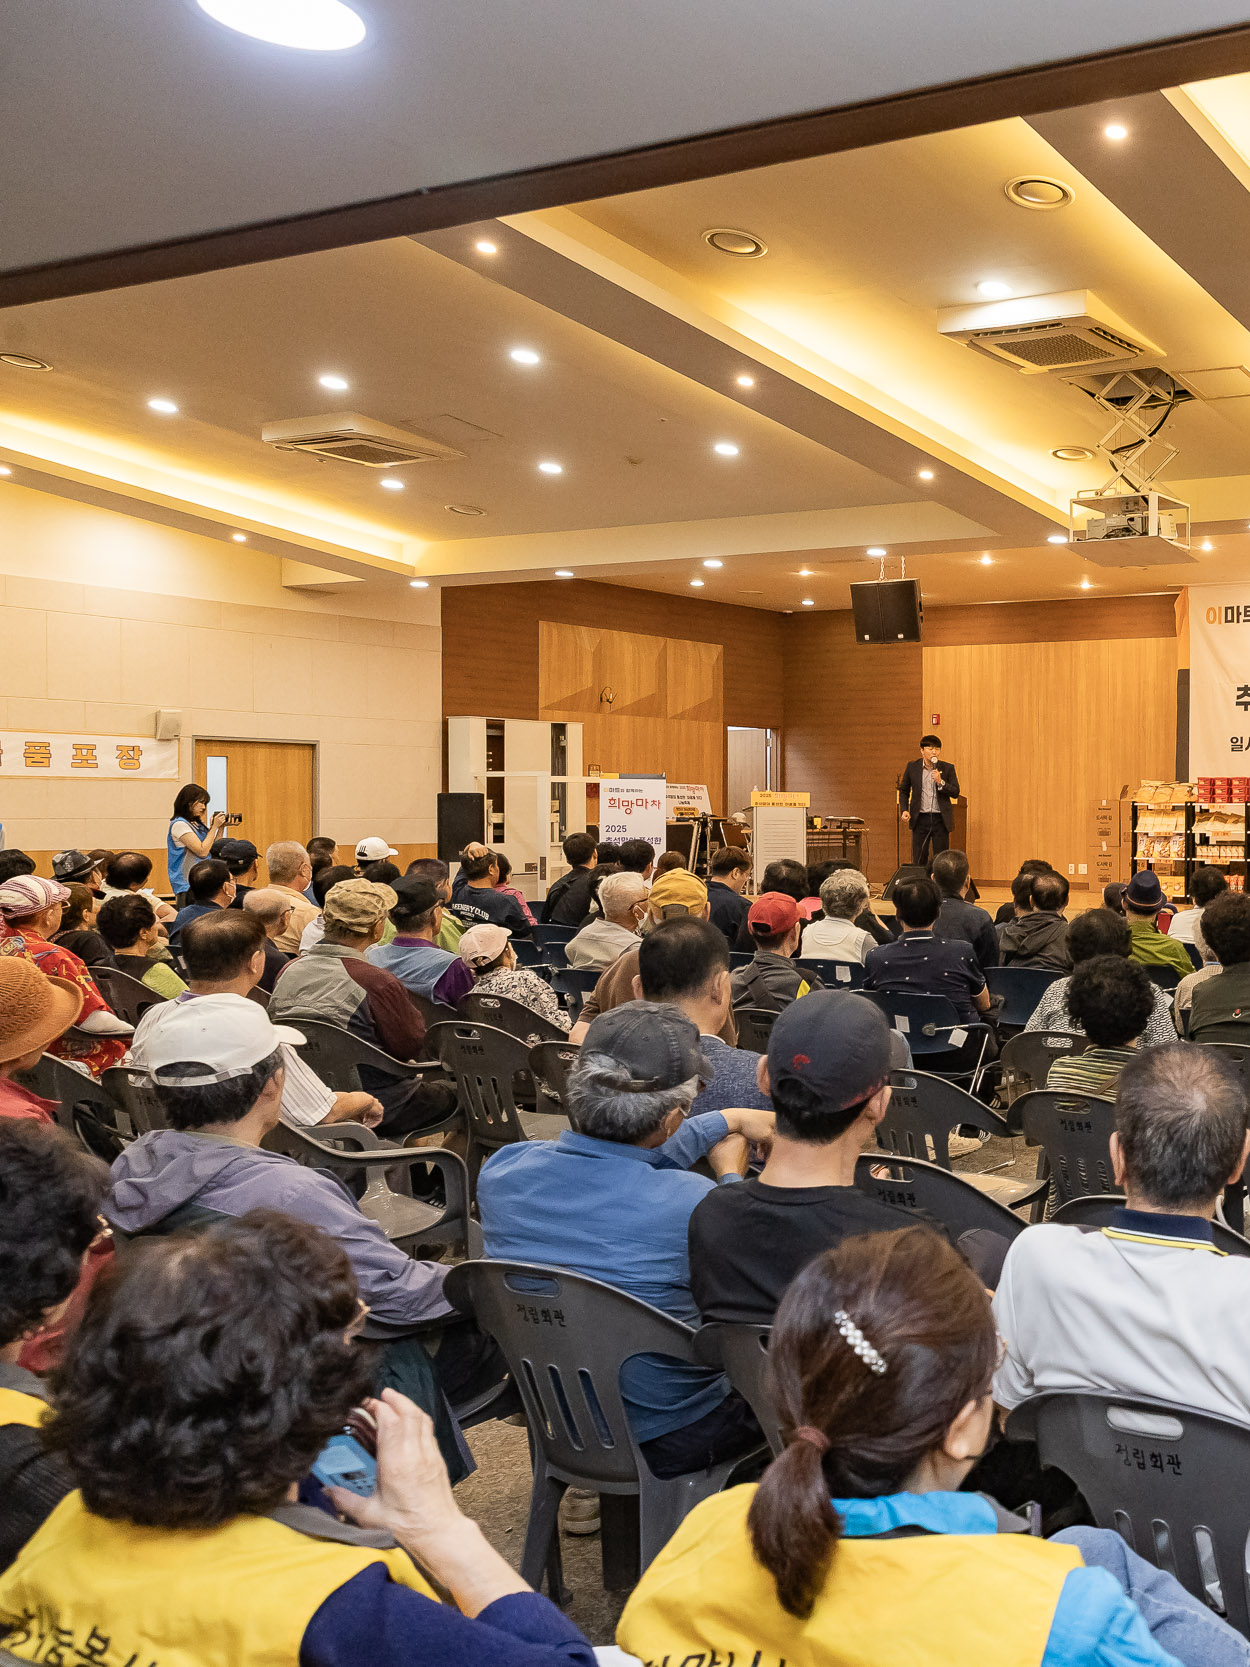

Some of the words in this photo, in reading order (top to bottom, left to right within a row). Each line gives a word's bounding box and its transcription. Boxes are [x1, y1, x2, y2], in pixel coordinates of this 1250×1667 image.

[607, 796, 661, 815] 희망마차
[605, 824, 627, 833] 2025
[516, 1303, 567, 1328] 정립회관
[1115, 1443, 1183, 1476] 정립회관
